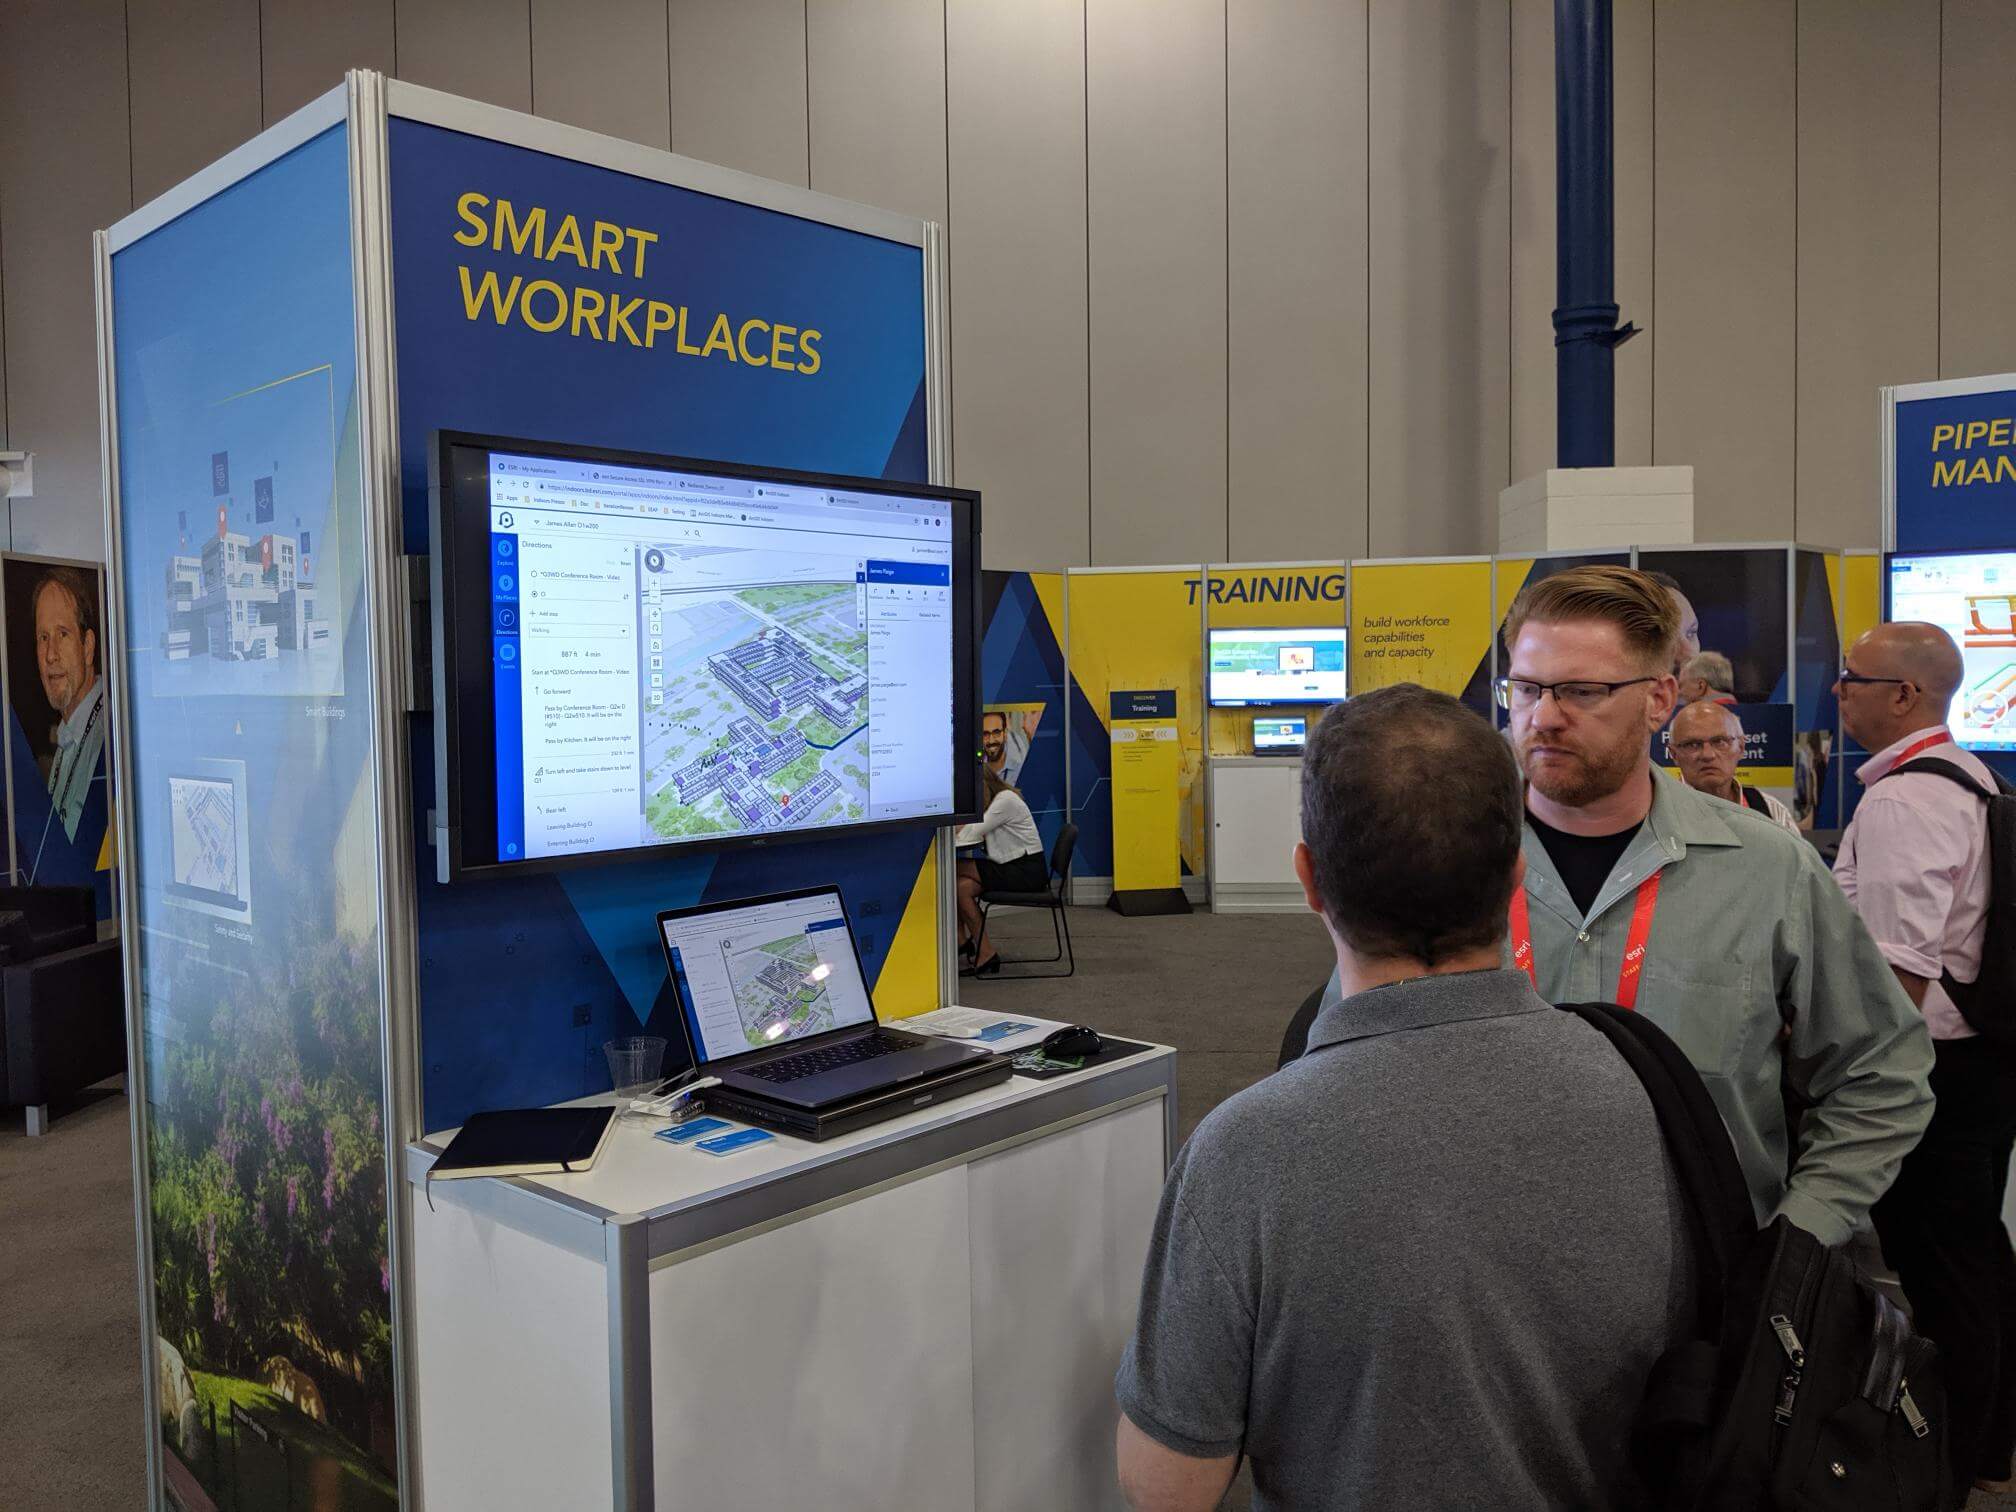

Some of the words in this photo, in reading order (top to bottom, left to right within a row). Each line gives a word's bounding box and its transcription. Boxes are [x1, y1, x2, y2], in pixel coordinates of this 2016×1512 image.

[453, 192, 658, 278] SMART
[458, 266, 822, 375] WORKPLACES
[1932, 418, 2016, 452] PIPE
[522, 540, 553, 550] Directions
[560, 572, 588, 580] Conference
[1183, 574, 1346, 606] TRAINING
[1364, 616, 1392, 628] build
[1394, 615, 1450, 627] workforce
[1364, 630, 1424, 644] capabilities
[1364, 647, 1386, 658] and
[1388, 646, 1435, 660] capacity
[568, 838, 589, 846] Building
[1514, 940, 1531, 958] esri
[1626, 943, 1646, 961] esri
[1622, 964, 1640, 978] STAFF
